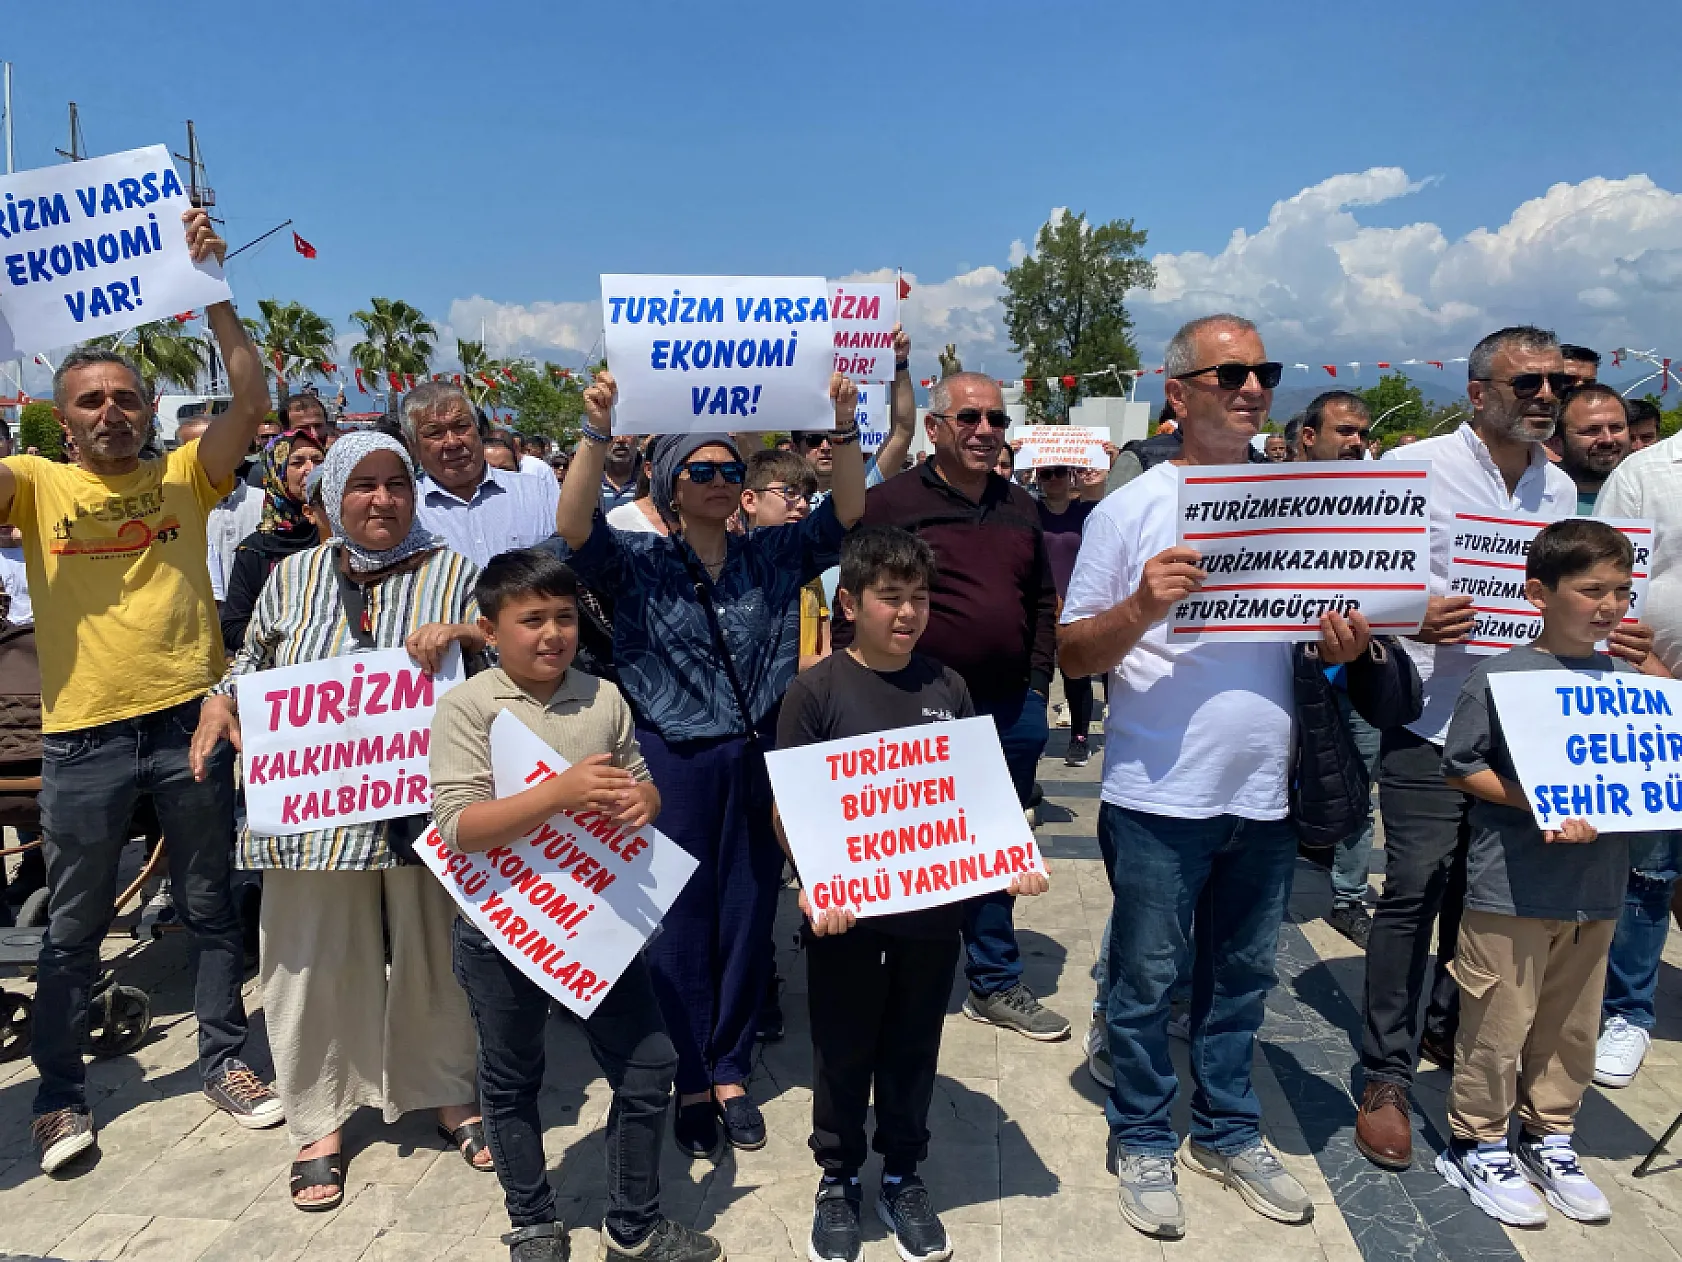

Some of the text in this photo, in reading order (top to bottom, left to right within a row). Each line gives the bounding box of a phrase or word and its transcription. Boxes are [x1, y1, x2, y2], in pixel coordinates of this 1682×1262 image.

[75, 168, 183, 218] VARSA
[5, 212, 163, 286] EKONOMİ
[64, 275, 143, 323] VAR!
[608, 289, 829, 326] TURİZM VARSA
[830, 288, 881, 320] İZM
[650, 330, 798, 372] EKONOMİ
[691, 384, 763, 417] VAR!
[1184, 488, 1427, 522] #TURİZMEKONOMİDİR
[1187, 546, 1418, 575] TURİZMKAZANDIRIR
[1175, 592, 1361, 624] #TURİZMGÜÇTÜR
[264, 662, 435, 732] TURİZM
[1555, 678, 1674, 717] TURİZM
[249, 728, 431, 784] KALKINMAN
[826, 735, 950, 780] TURİZMLE
[281, 768, 434, 824] KALBİDİR
[841, 776, 956, 821] BÜYÜYEN
[1534, 773, 1633, 823] ŞEHİR
[523, 823, 616, 895] YÜYEN
[846, 807, 976, 863] EKONOMİ,
[486, 845, 595, 940] KONOMİ,
[812, 842, 1035, 913] GÜÇLÜ YARINLAR!
[479, 890, 609, 1002] YARINLAR!
